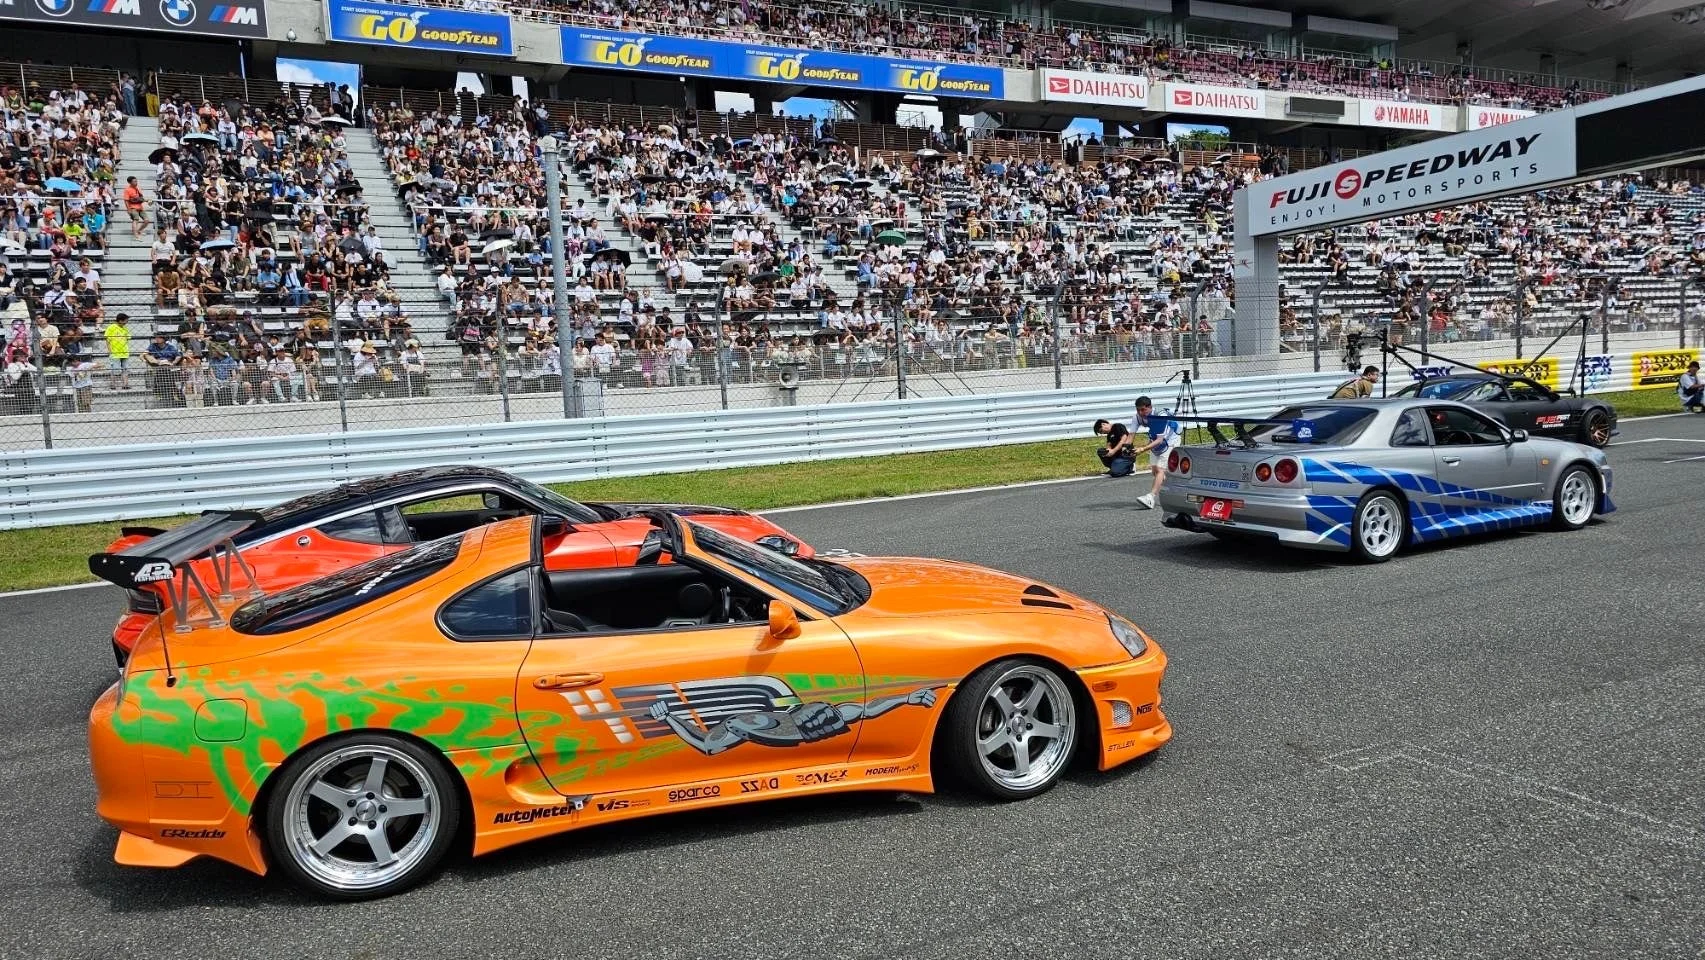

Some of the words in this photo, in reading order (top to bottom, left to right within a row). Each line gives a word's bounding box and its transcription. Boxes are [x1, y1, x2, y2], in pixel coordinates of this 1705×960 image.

[361, 15, 417, 43] GO
[421, 30, 498, 46] GOODYEAR
[596, 41, 642, 67] GO
[646, 55, 710, 68] GOODYEAR
[759, 57, 801, 81] GO
[803, 68, 858, 81] GOODYEAR
[902, 69, 937, 92] GO
[940, 80, 990, 92] GOODYEAR
[1073, 79, 1145, 99] DAIHATSU
[1195, 92, 1259, 111] DAIHATSU
[1387, 107, 1429, 125] YAMAHA
[1270, 181, 1332, 209] FUJI
[1271, 203, 1336, 226] ENJOY!
[1363, 163, 1539, 208] MOTORSPORTS
[1200, 479, 1217, 487] TOYO
[1218, 481, 1240, 489] TIRES
[668, 784, 721, 802] sparco
[160, 828, 227, 839] GReddy
